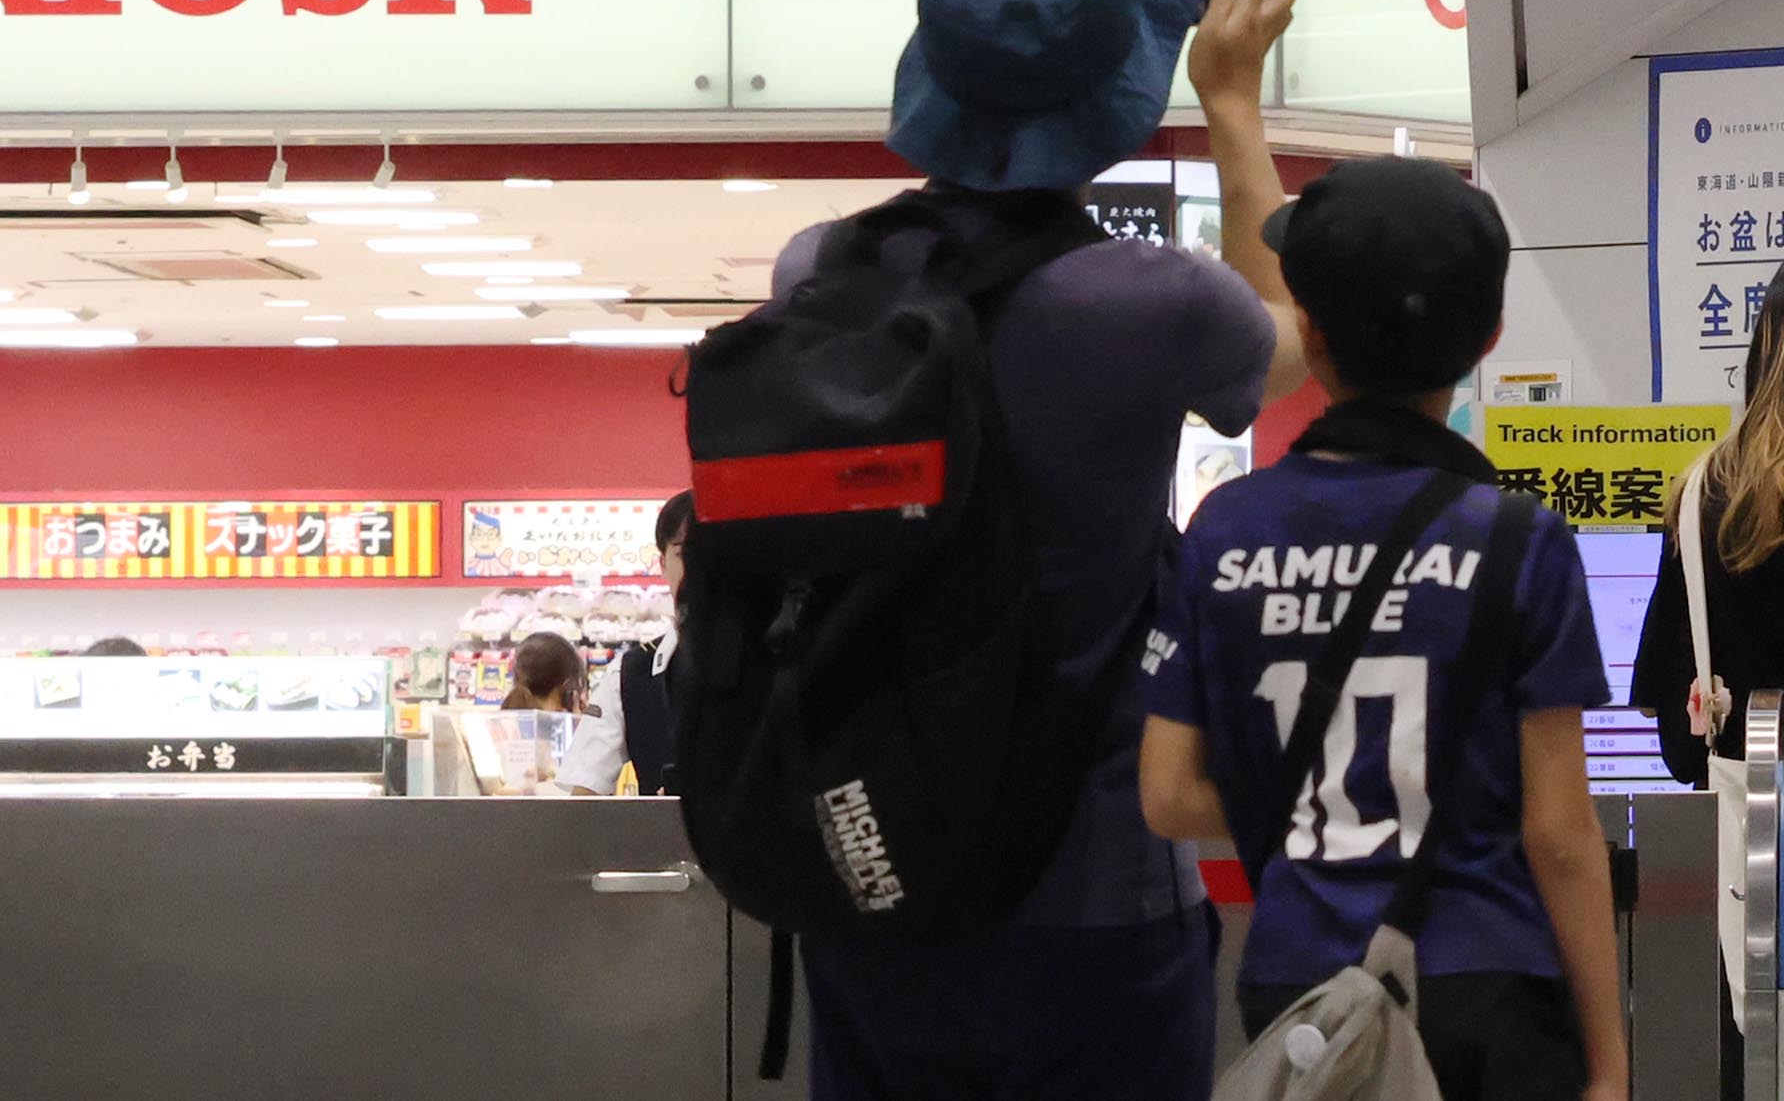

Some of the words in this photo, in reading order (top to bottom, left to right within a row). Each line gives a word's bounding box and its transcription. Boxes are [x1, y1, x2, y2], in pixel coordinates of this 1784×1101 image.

[1498, 424, 1563, 443] Track
[1572, 424, 1716, 443] information
[1496, 467, 1673, 519] 番線案
[44, 514, 171, 556] おつまみ
[204, 512, 393, 556] スナック菓子
[146, 740, 237, 771] お弁当
[1252, 656, 1432, 860] 10
